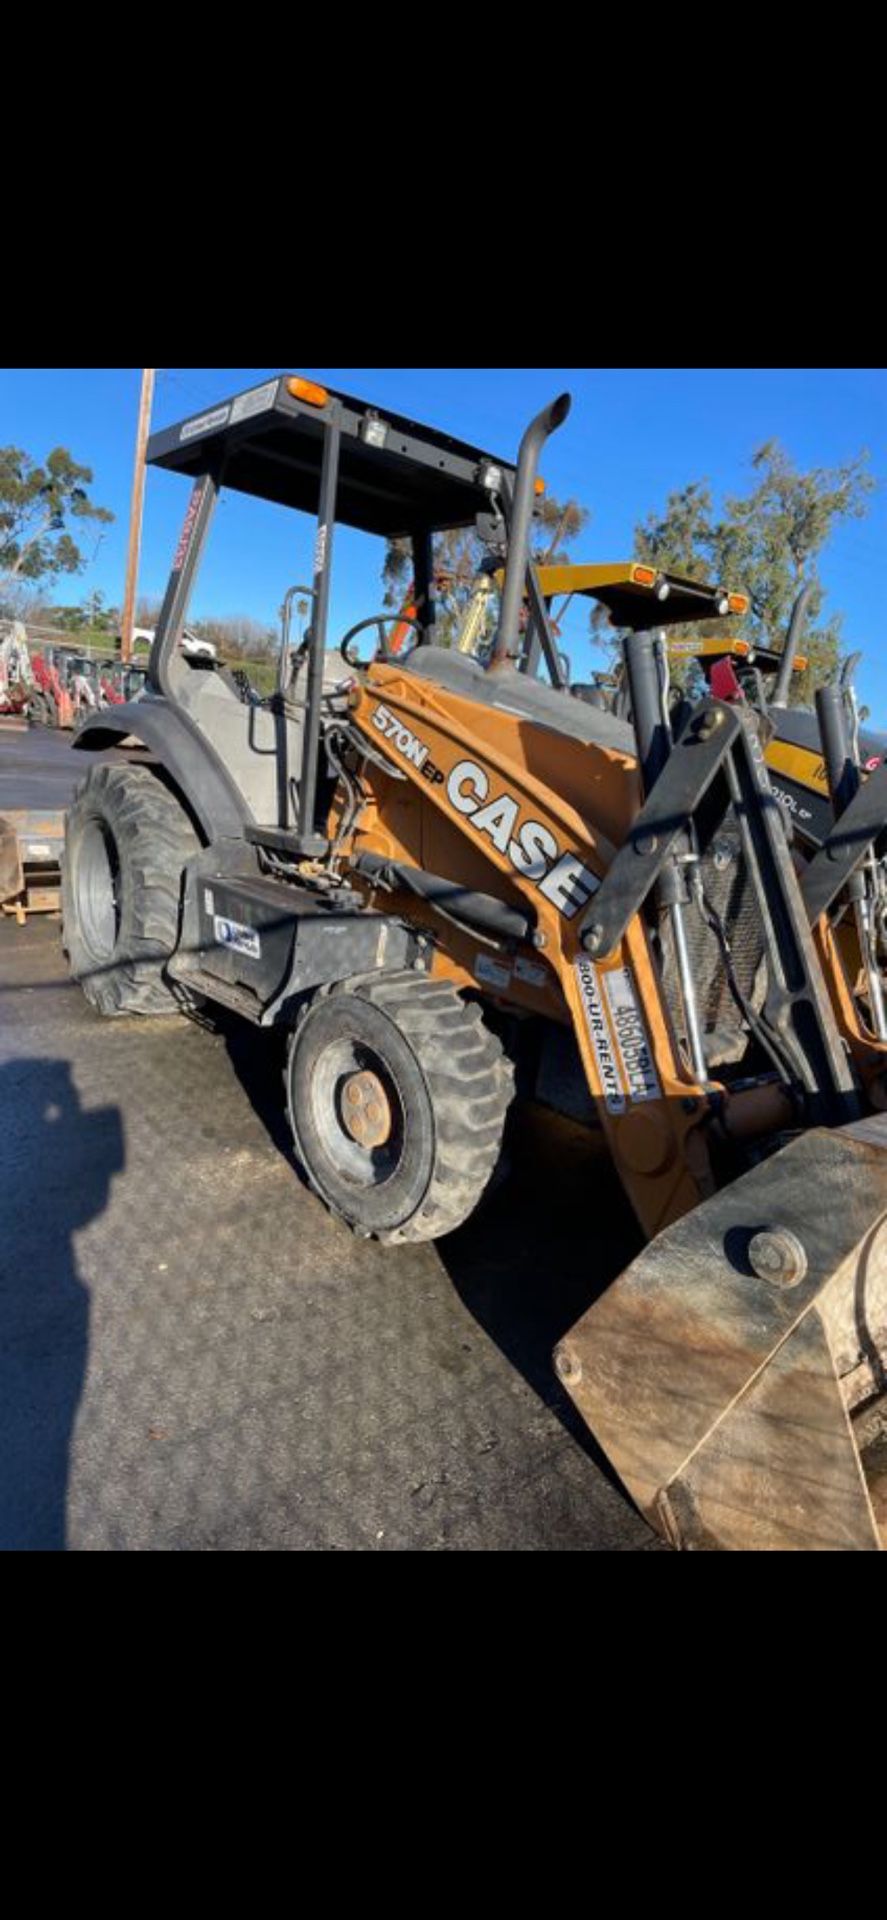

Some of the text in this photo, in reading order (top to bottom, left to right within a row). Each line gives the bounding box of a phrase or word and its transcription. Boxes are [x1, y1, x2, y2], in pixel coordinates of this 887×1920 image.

[372, 704, 444, 784] 570N EP
[447, 760, 602, 920] CASE
